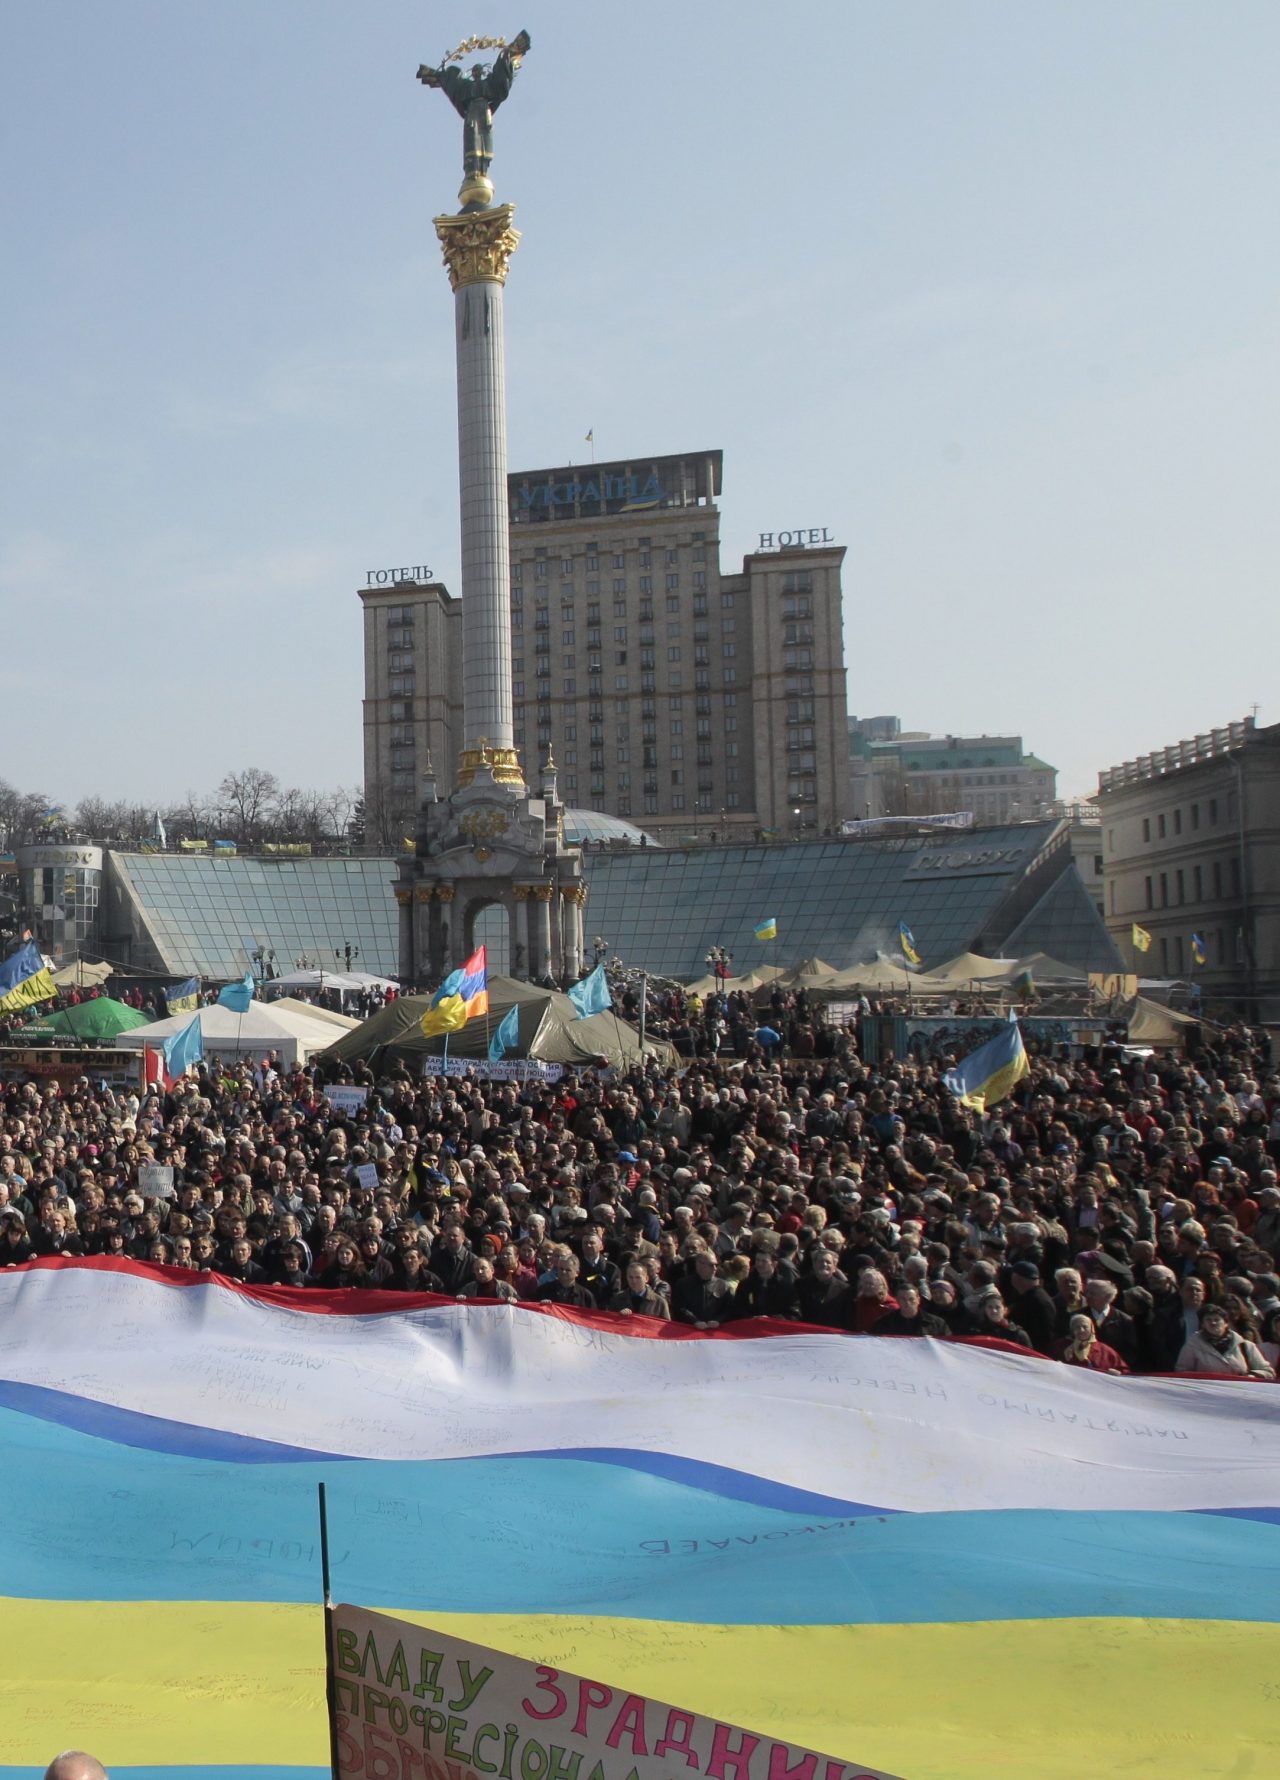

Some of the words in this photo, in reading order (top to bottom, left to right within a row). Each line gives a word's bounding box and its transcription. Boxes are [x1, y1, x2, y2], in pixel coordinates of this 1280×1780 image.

[518, 474, 666, 506] УКРАЇНА
[758, 528, 835, 547] HOTEL
[366, 566, 434, 585] ГОТЕЛЬ
[975, 1393, 1191, 1442] ПАМ'ЯТАЙМО
[638, 1517, 888, 1556] ИКОЛАЕВ
[336, 1628, 495, 1712] ВЛАДУ
[334, 1675, 640, 1780] ПРОФЕСІОН
